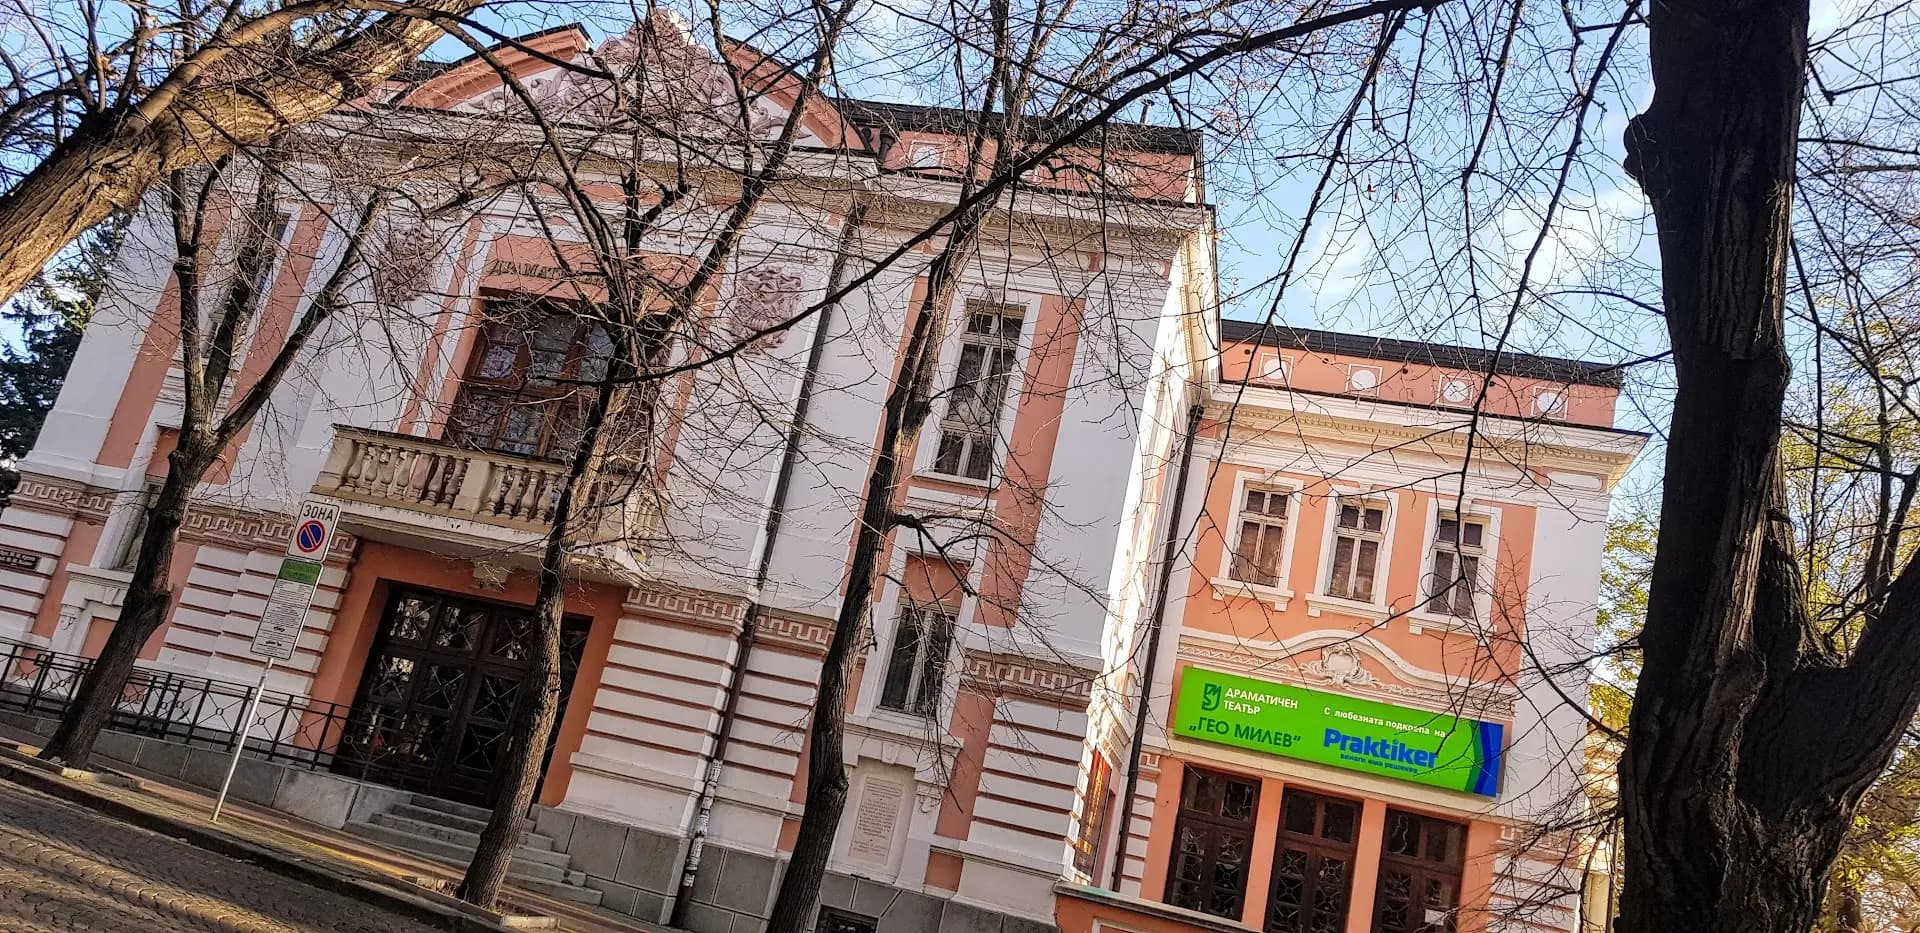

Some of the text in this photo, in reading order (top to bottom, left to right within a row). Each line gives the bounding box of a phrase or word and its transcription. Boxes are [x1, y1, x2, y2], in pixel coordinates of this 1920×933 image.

[303, 504, 334, 521] ЗОНА
[1223, 700, 1261, 715] ТЕАТЪР
[1224, 687, 1298, 709] ДРАМАТИЧЕН
[1324, 706, 1331, 715] С
[1334, 709, 1384, 726] любезната
[1434, 729, 1446, 738] на
[1323, 727, 1437, 768] Praktiker
